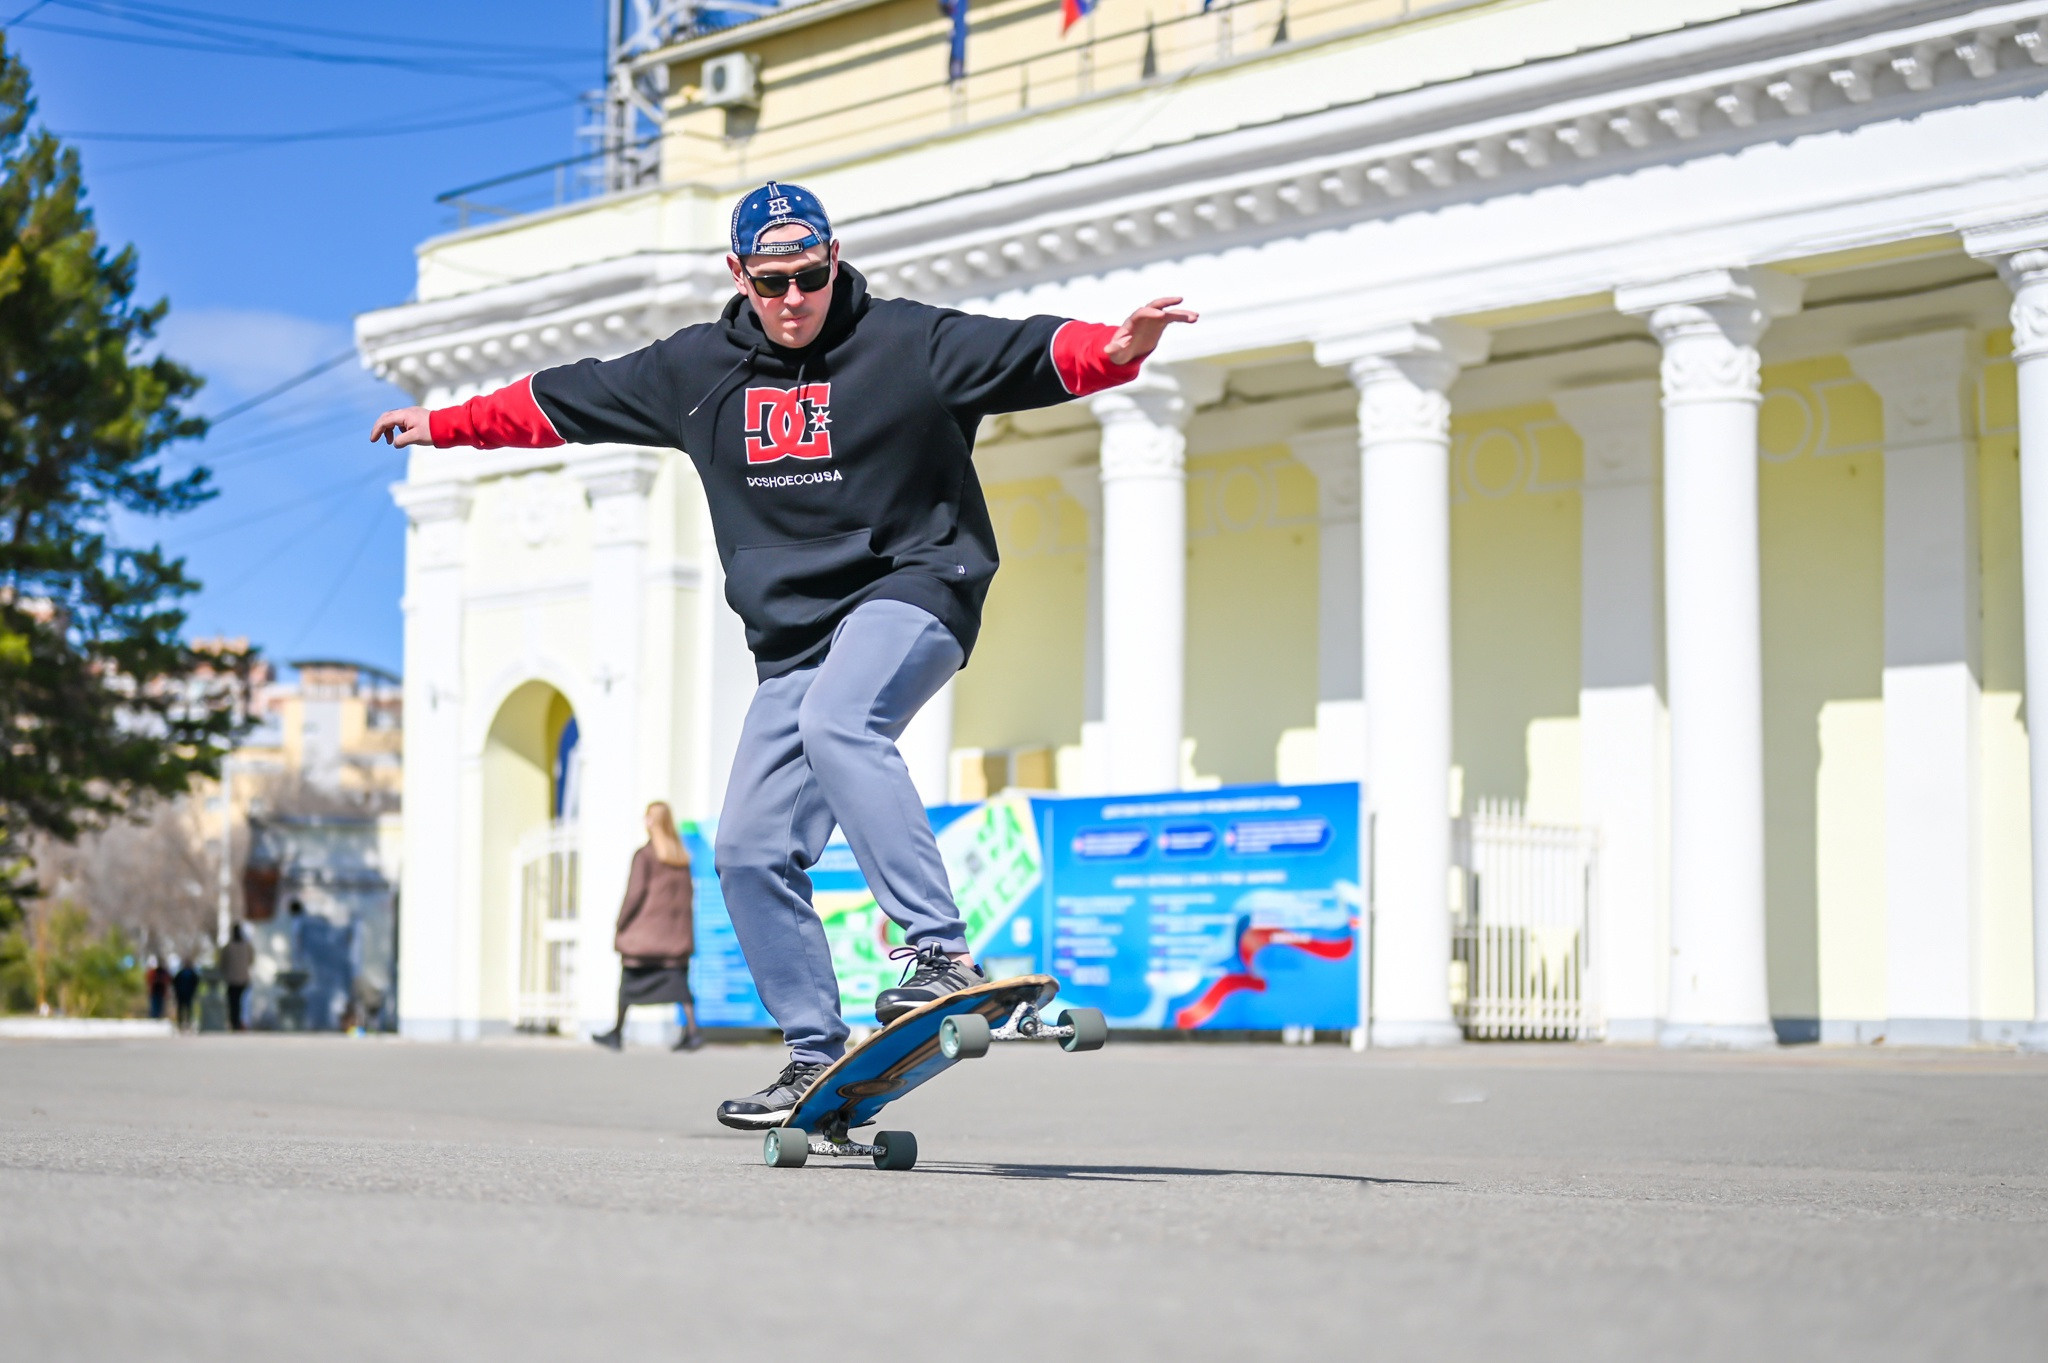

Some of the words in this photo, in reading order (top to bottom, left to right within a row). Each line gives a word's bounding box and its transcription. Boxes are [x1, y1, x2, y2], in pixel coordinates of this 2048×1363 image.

[760, 244, 800, 253] AMSTERDAM
[744, 382, 832, 464] DC
[746, 469, 843, 488] DCSHOECOUSA
